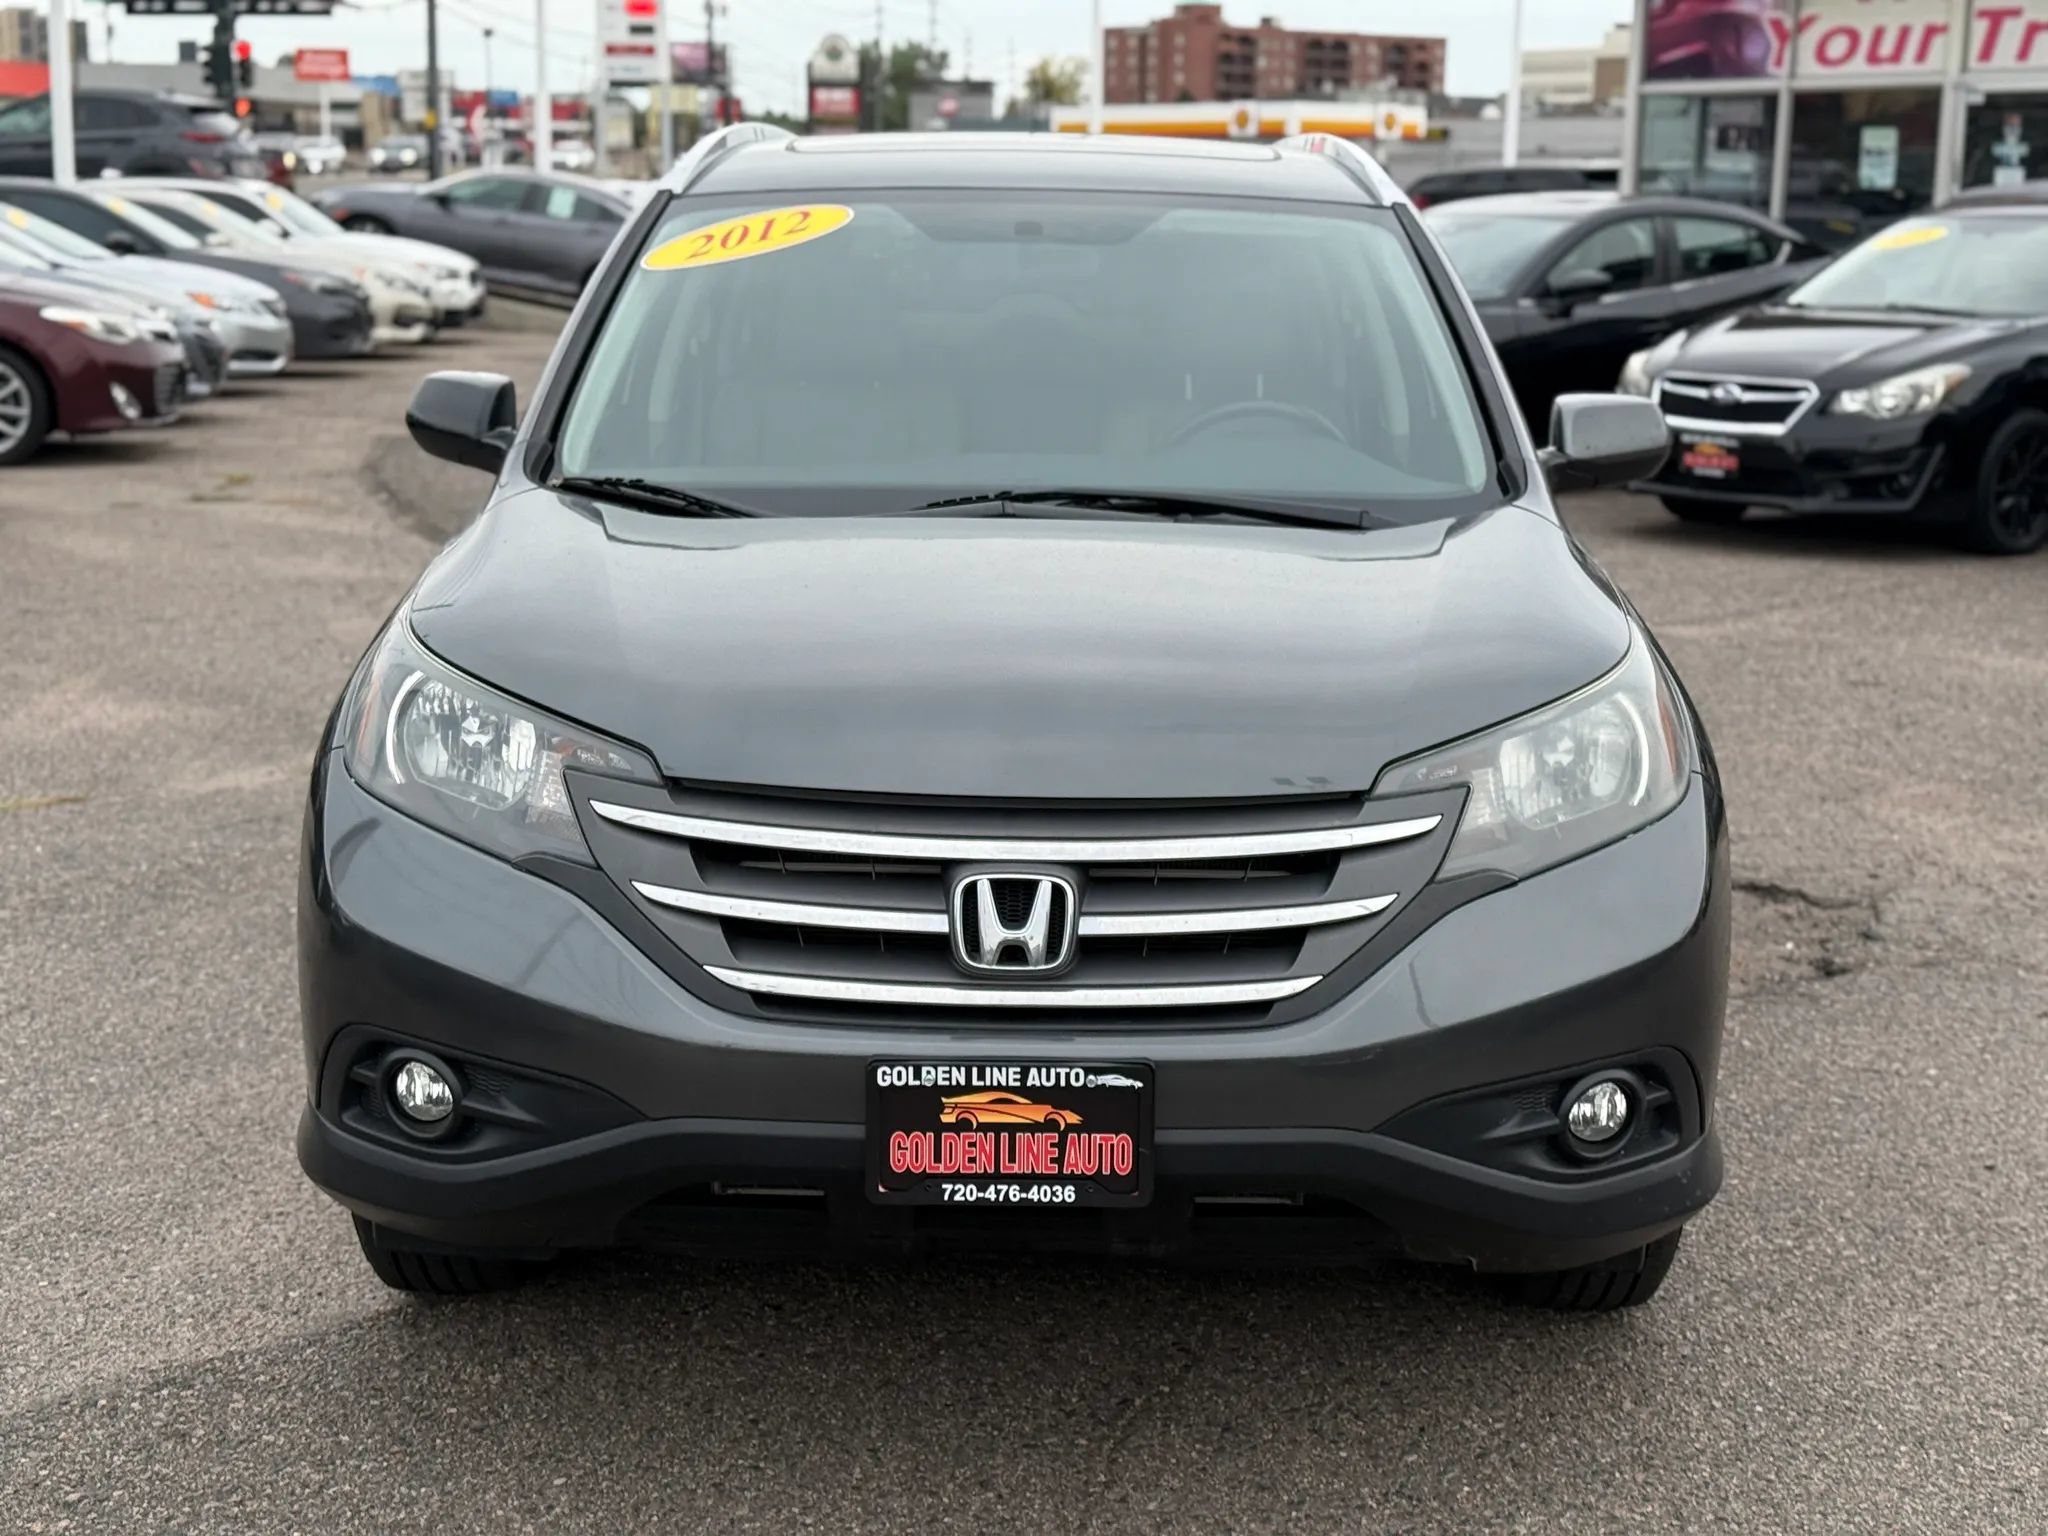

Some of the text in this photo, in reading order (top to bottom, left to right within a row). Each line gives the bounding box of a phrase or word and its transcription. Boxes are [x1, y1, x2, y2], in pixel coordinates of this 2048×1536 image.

[1768, 13, 1949, 69] Your
[685, 210, 812, 261] 2012
[876, 1065, 1085, 1088] GOLDEN LINE AUTO
[889, 1130, 1133, 1176] GOLDEN LINE AUTO
[941, 1183, 1077, 1204] 720-476-4036
